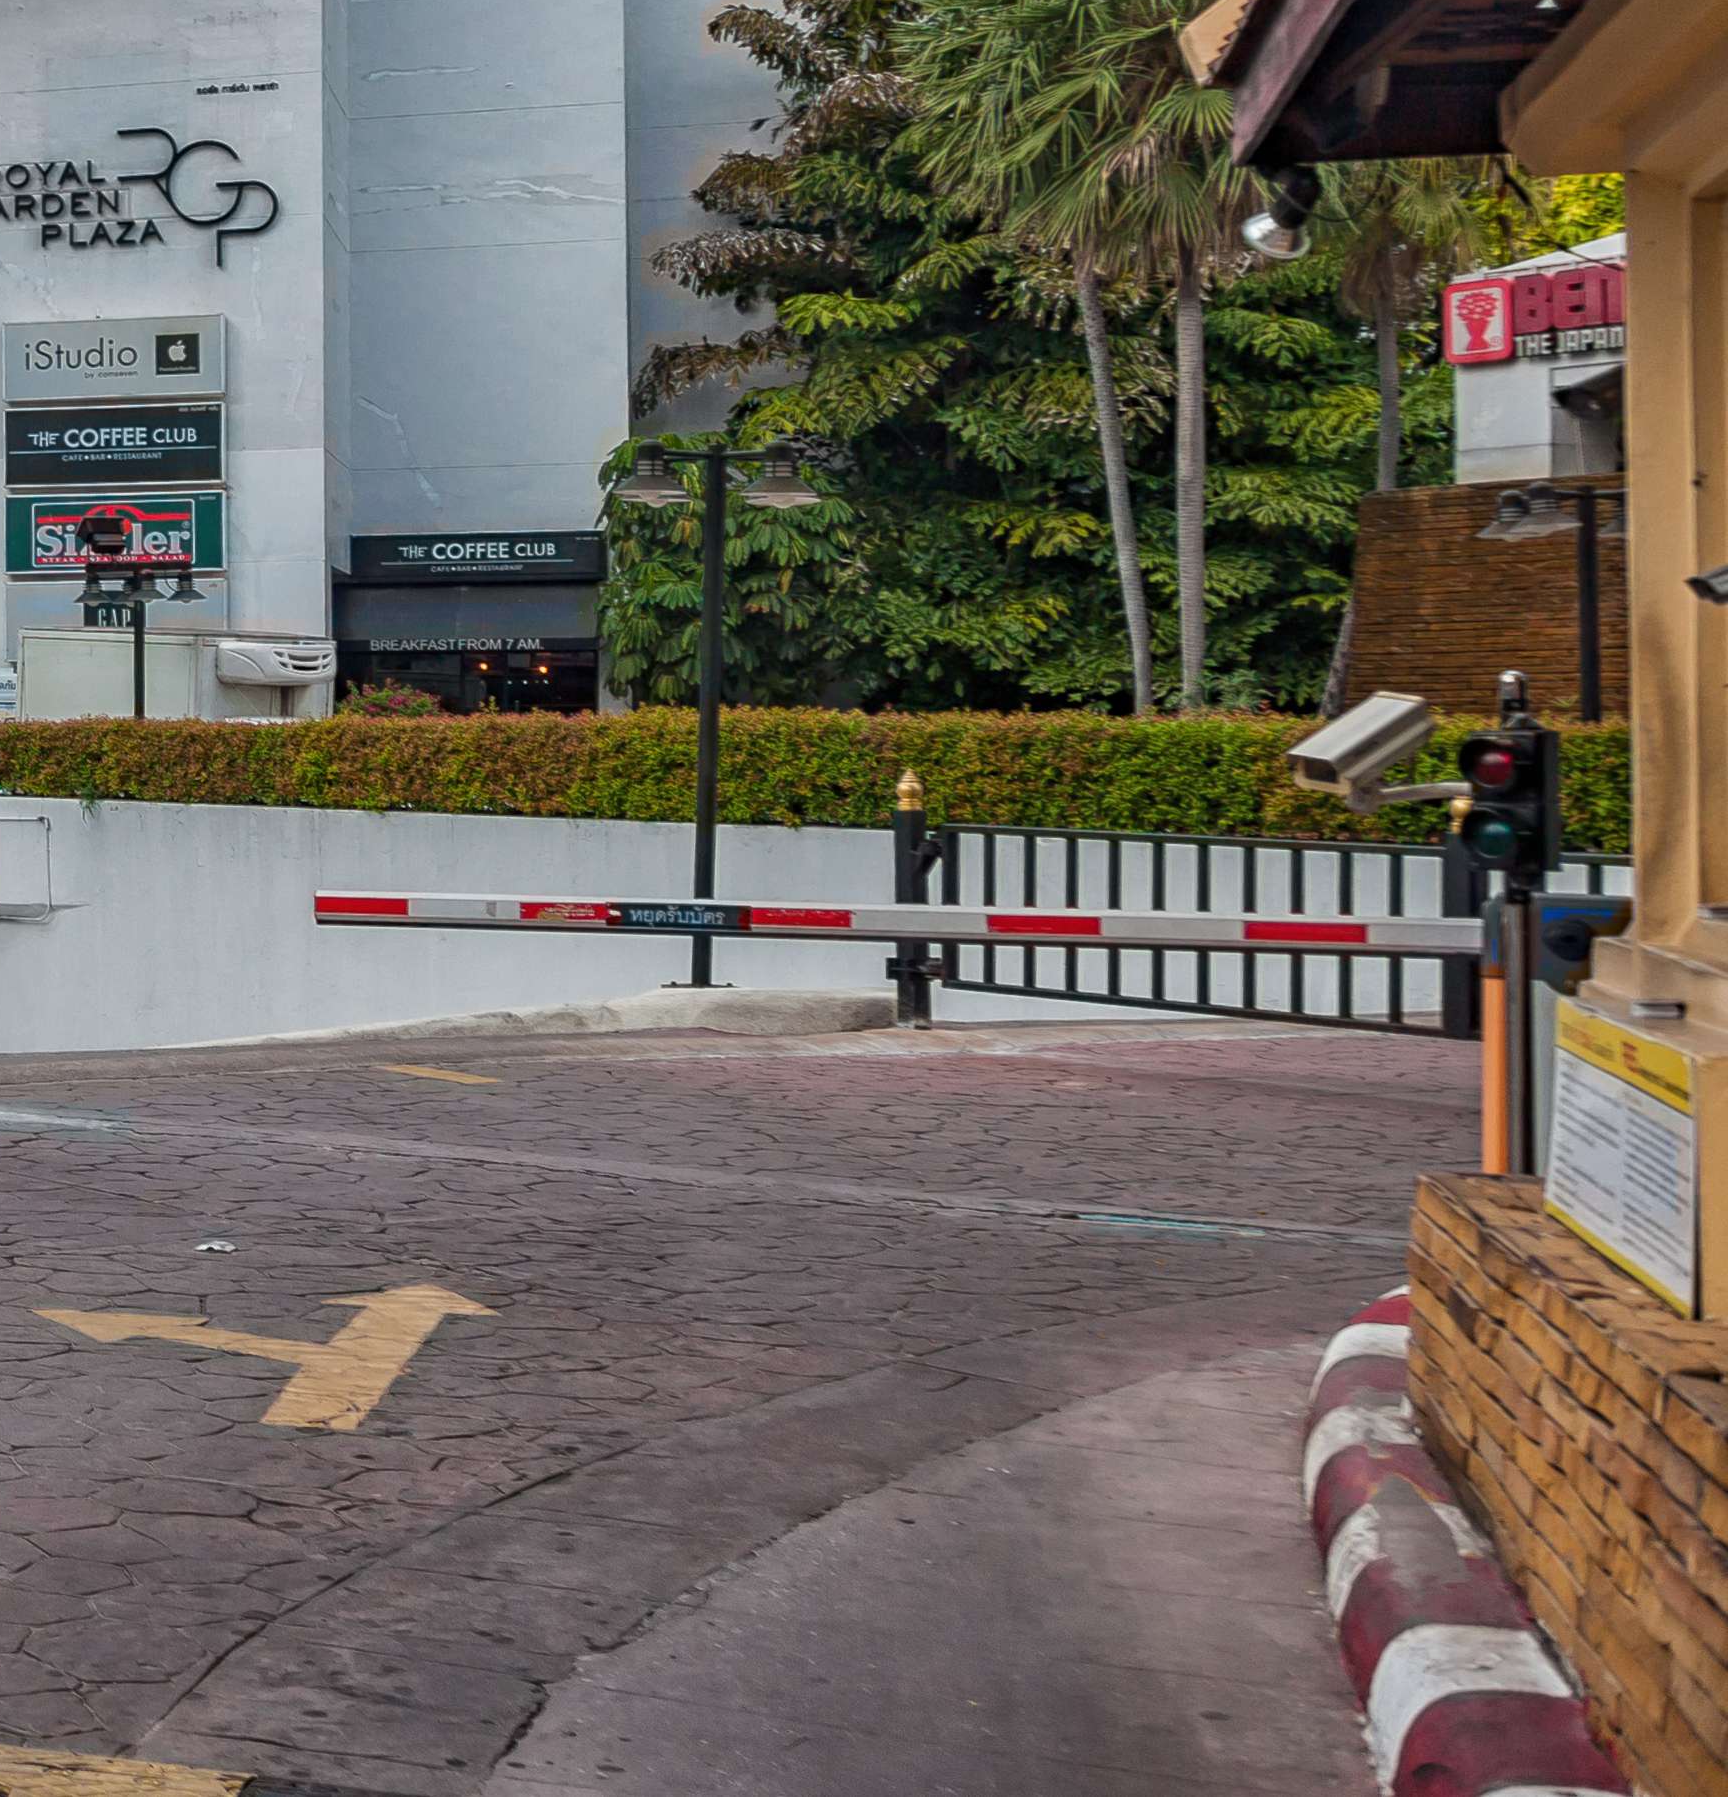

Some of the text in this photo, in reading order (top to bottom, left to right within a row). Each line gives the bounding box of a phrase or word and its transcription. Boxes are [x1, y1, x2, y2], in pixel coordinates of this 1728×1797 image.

[40, 220, 165, 248] PLAZA
[25, 337, 138, 371] iStudio
[1515, 332, 1552, 357] THE
[27, 427, 197, 448] THE COFFEE CLUB
[36, 522, 191, 557] Siler
[42, 553, 185, 564] STEAK SEAOOD SALAD
[398, 542, 556, 560] THE COFFEE CLUB
[97, 608, 131, 627] GAP
[370, 638, 544, 651] BREAKFAST FROM 7 AM.
[629, 905, 727, 927] หยุดรับบัตร
